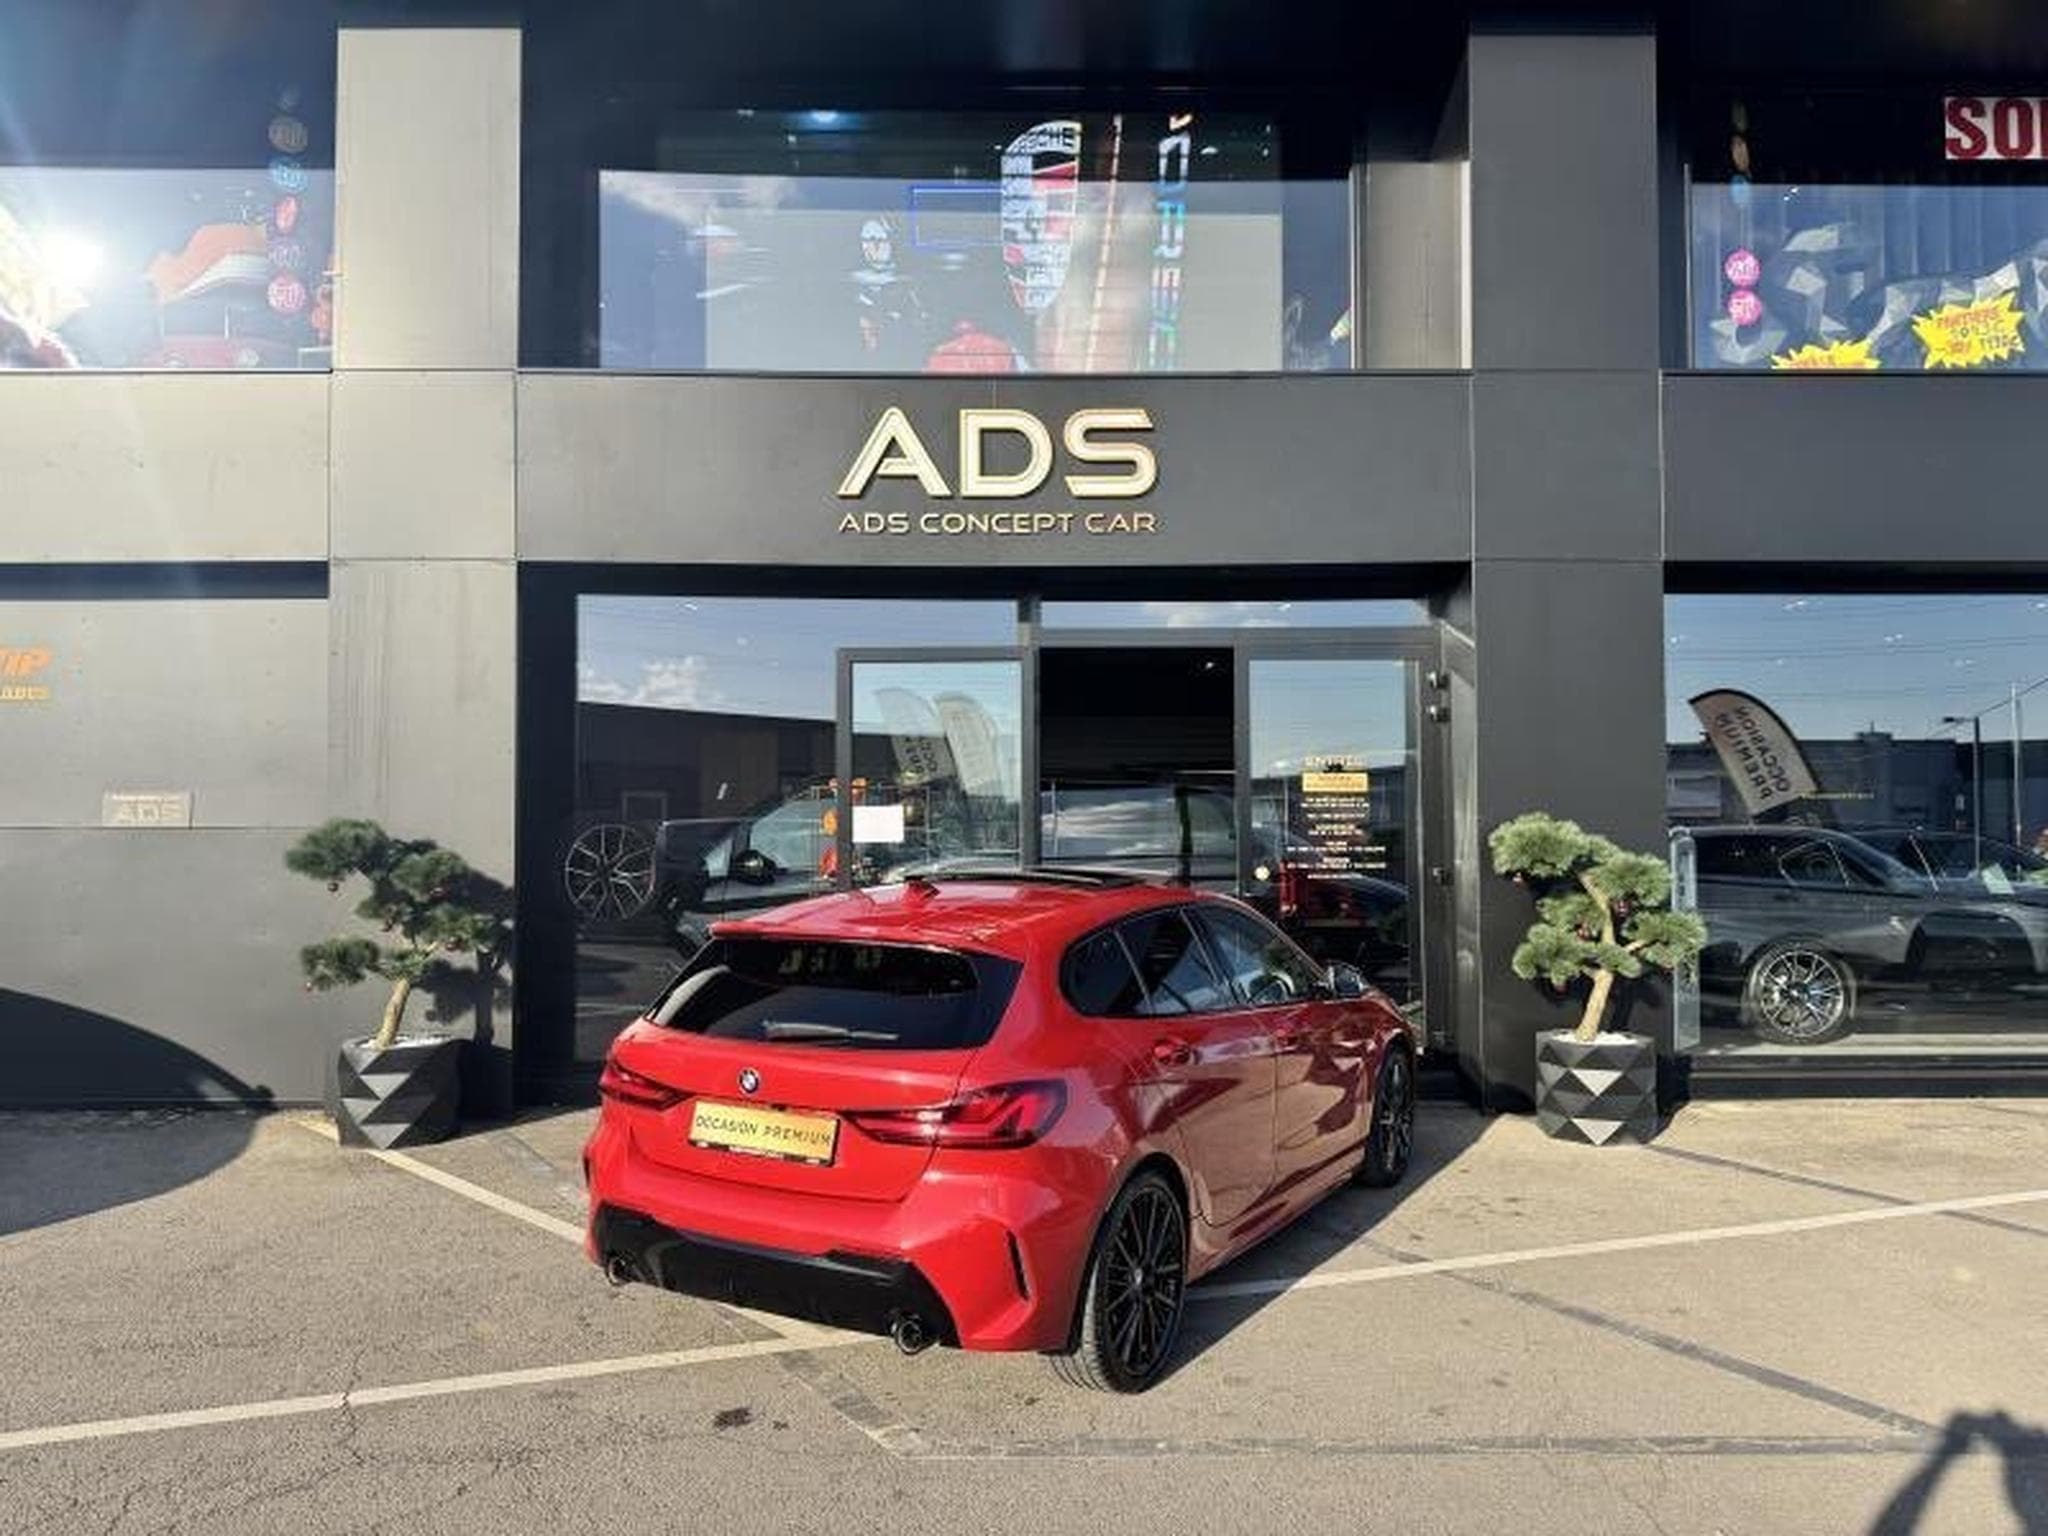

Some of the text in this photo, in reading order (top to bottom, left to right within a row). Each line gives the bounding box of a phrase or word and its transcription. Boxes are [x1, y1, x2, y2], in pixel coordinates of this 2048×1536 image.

[1946, 97, 2048, 157] SO
[837, 405, 1158, 499] ADS
[838, 513, 1158, 535] ADS CONCEPT CAR
[695, 1115, 832, 1146] OCCASION PREMIUM
